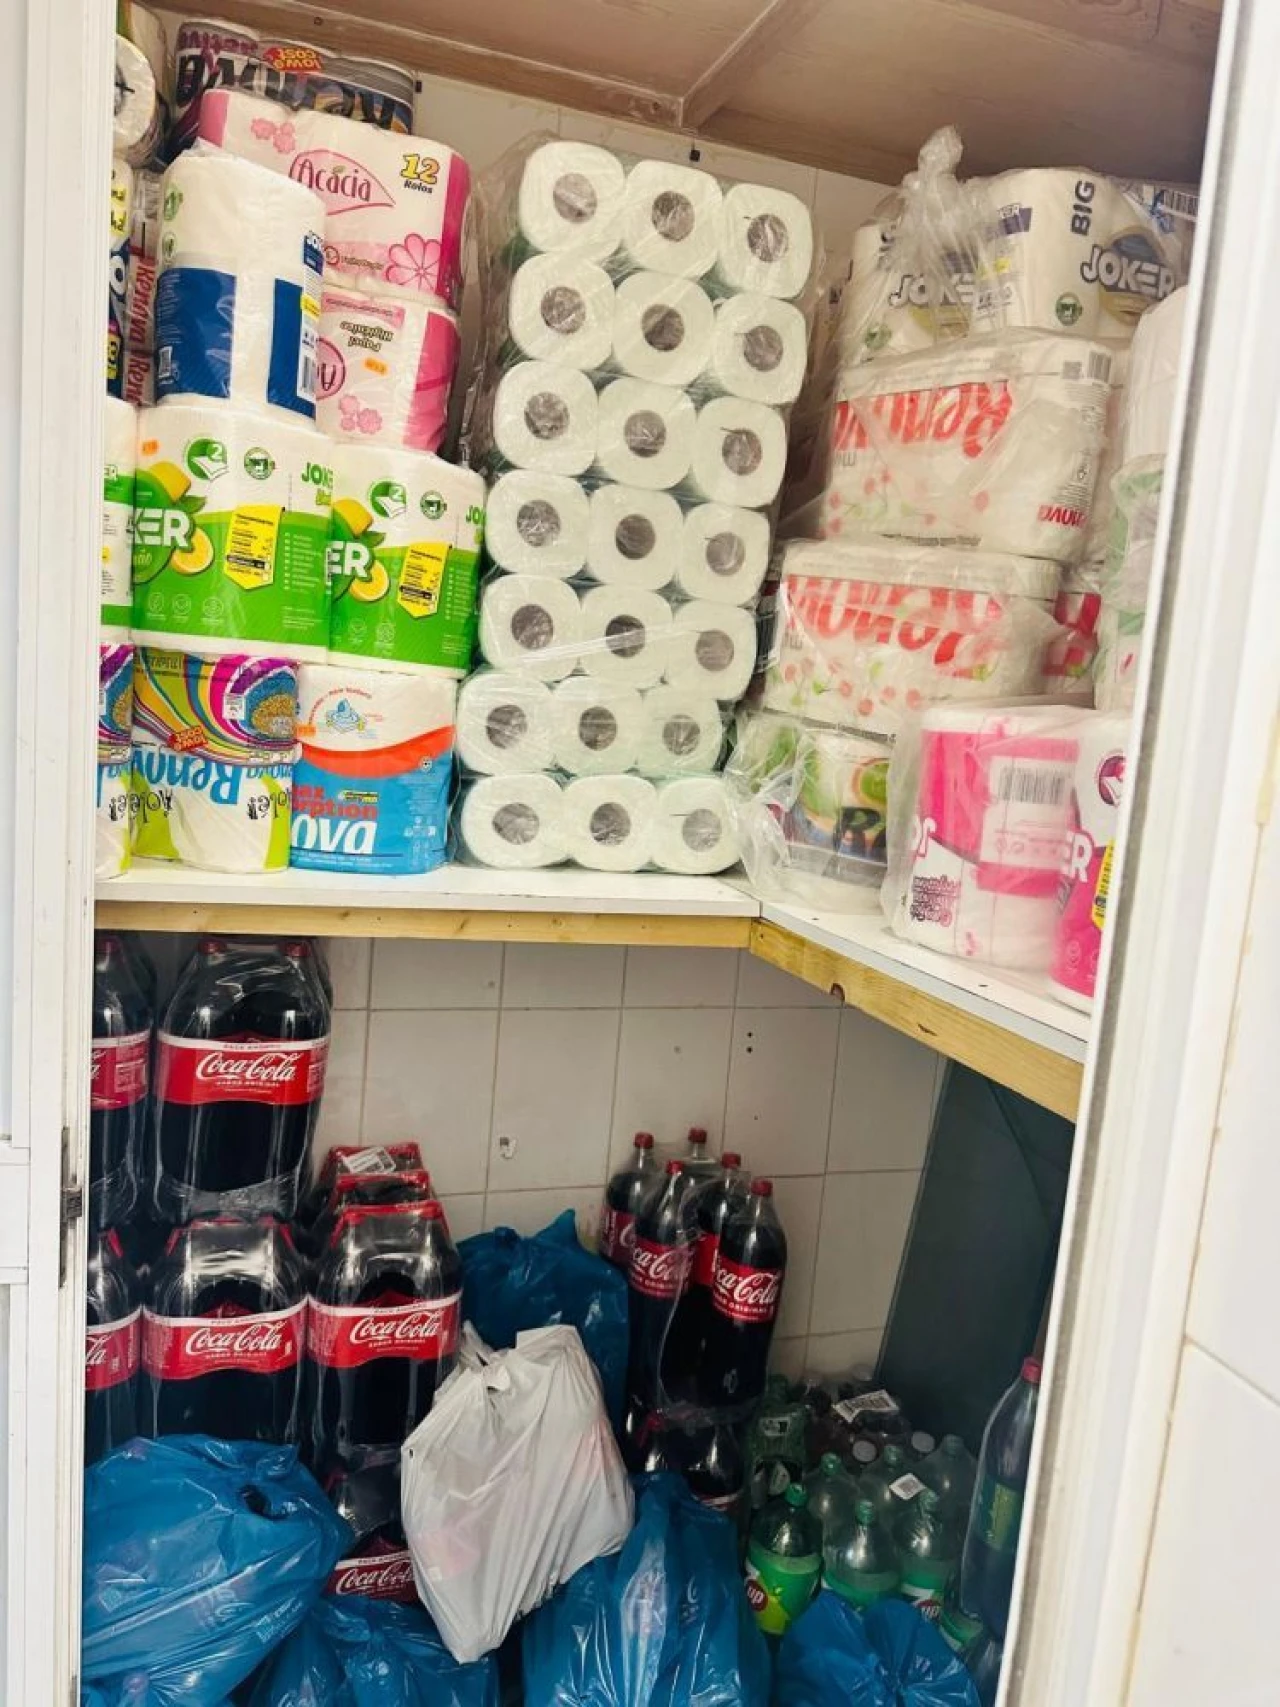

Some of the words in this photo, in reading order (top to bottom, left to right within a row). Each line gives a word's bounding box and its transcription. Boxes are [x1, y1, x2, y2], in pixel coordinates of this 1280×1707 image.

[400, 152, 441, 185] 12
[403, 180, 433, 194] Rolos
[1070, 180, 1095, 236] BIG
[1080, 243, 1176, 299] JOKER
[209, 443, 223, 460] 2
[195, 1052, 304, 1082] Coca-Cola
[185, 1321, 287, 1355] Coca-Cola
[350, 1310, 445, 1344] Coca-Cola
